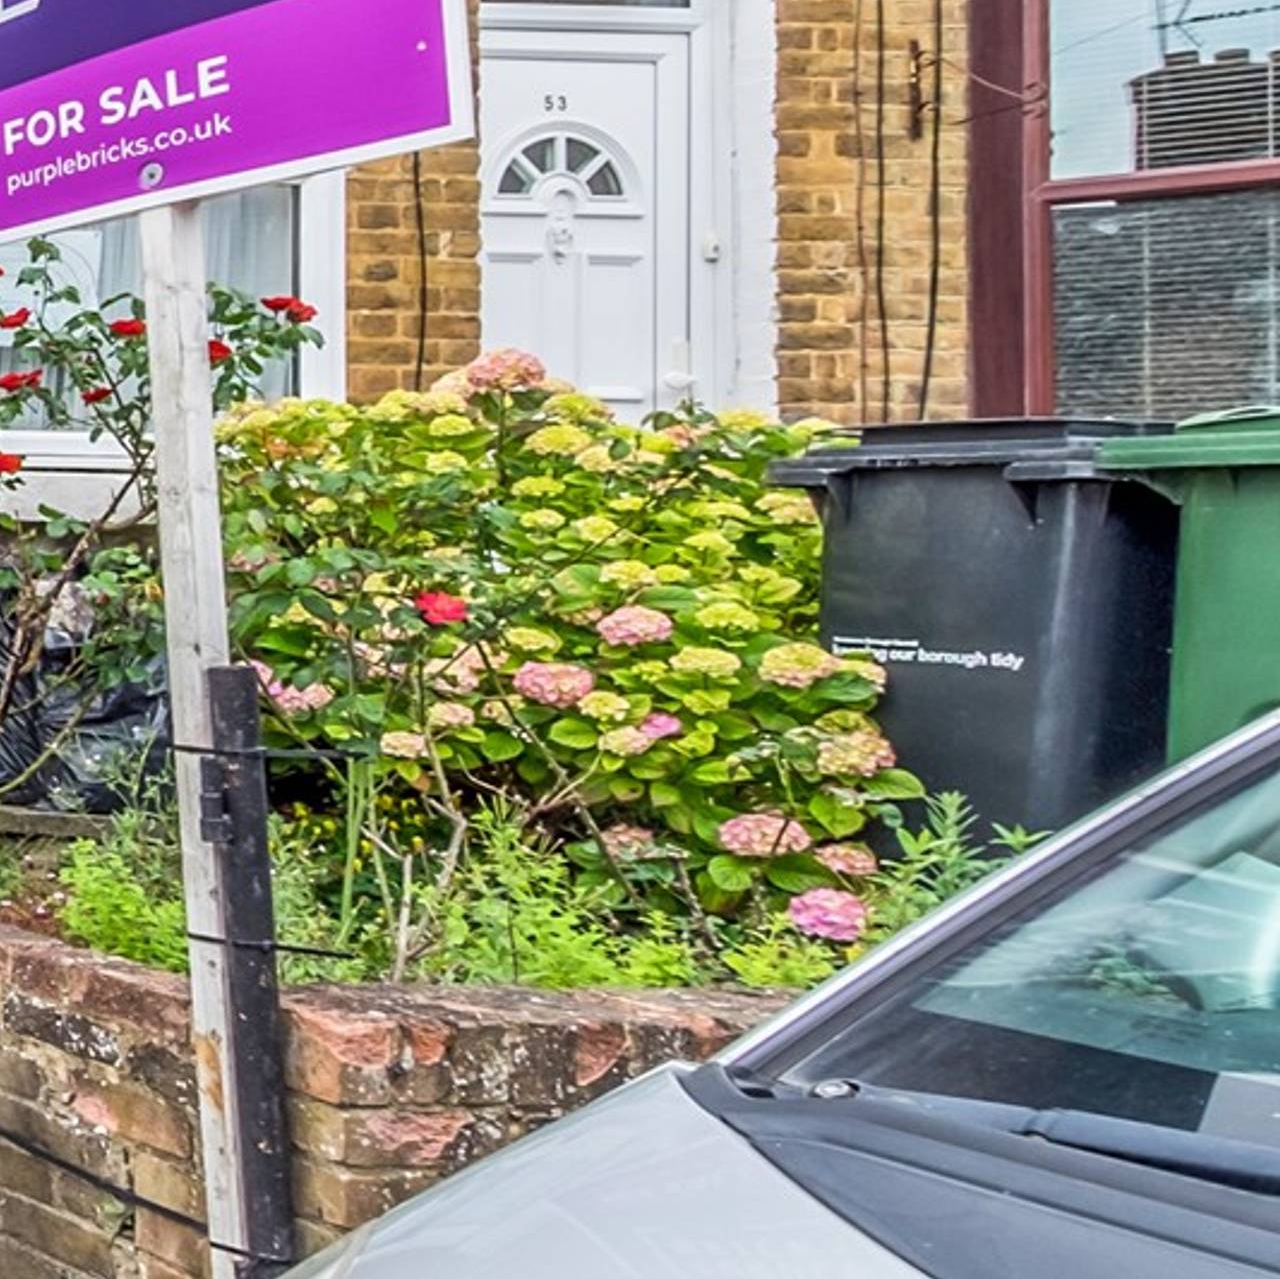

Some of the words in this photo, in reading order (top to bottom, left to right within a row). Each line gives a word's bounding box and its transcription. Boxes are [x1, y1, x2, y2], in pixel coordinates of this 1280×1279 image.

[3, 100, 85, 155] FOR
[98, 55, 230, 125] SALE
[544, 95, 568, 112] 53
[7, 112, 232, 196] purplebricks.co.uk
[889, 648, 917, 661] our
[917, 647, 988, 668] borough
[990, 652, 1025, 671] tidy
